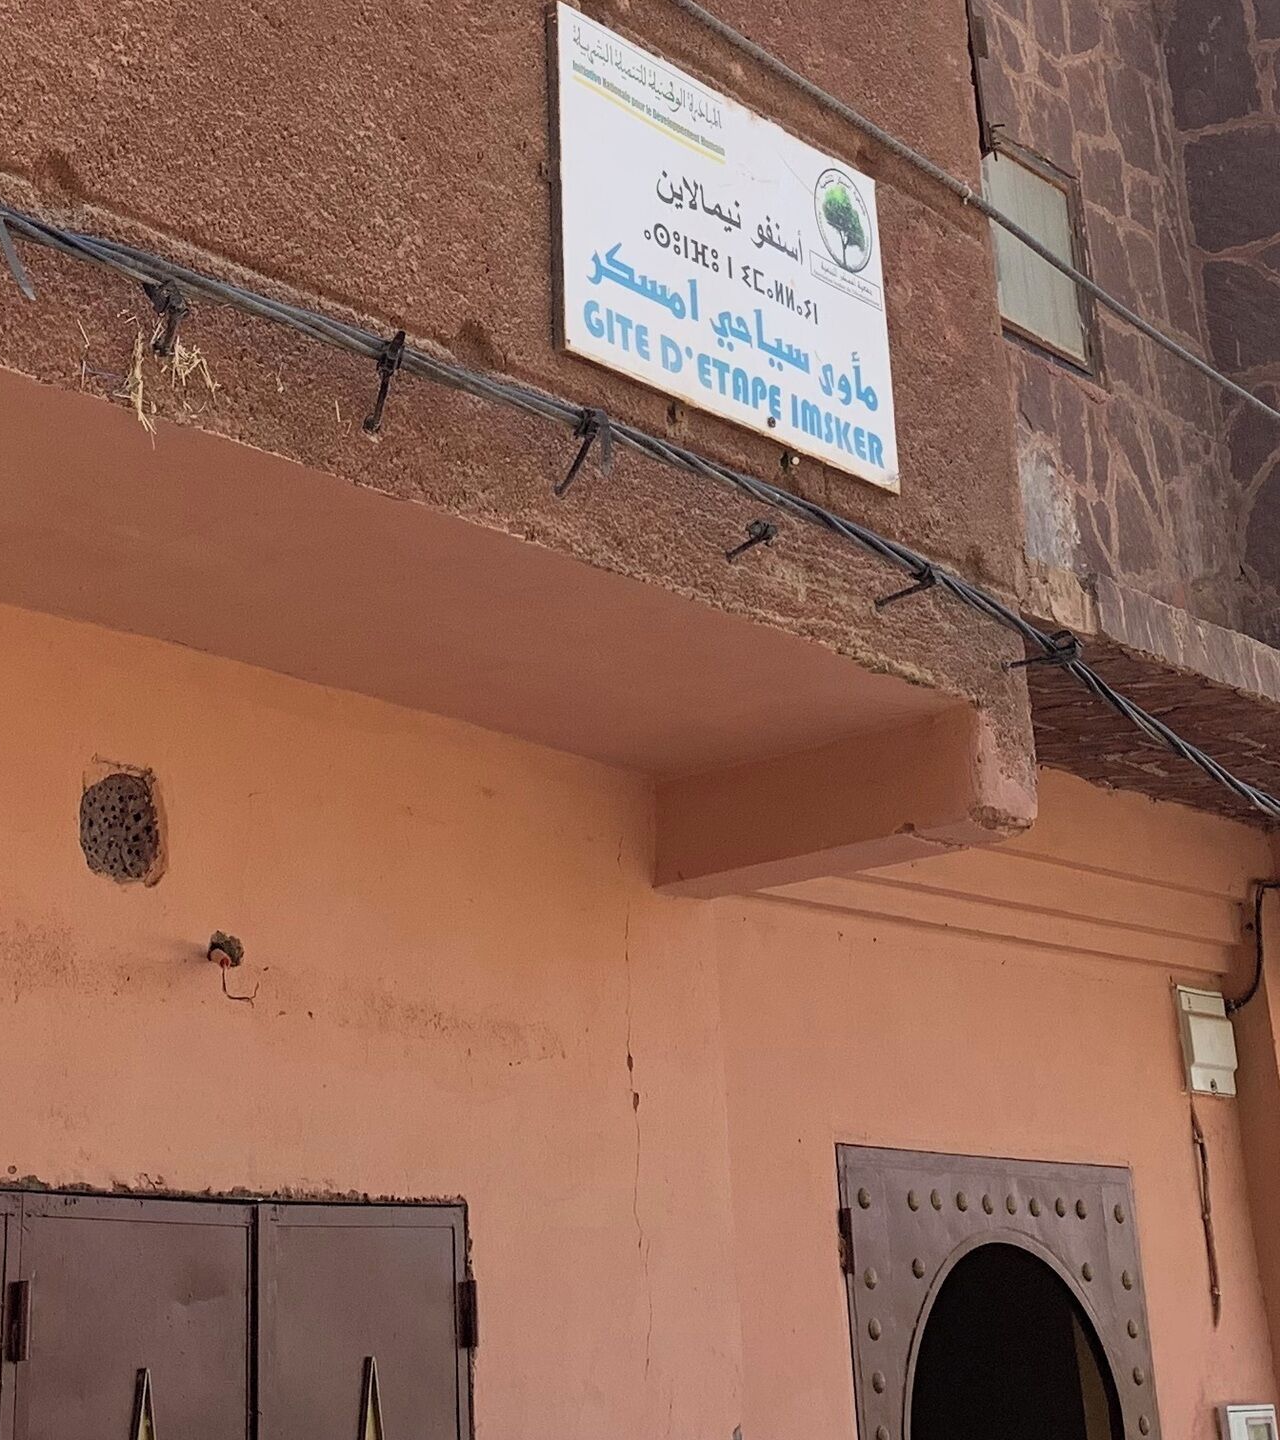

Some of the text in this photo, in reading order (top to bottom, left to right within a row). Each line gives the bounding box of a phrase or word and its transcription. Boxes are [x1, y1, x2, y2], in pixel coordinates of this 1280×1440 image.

[583, 300, 885, 469] GITE D'ETAPE IMSKER
[586, 242, 879, 412] مأوى سياحي امسكر
